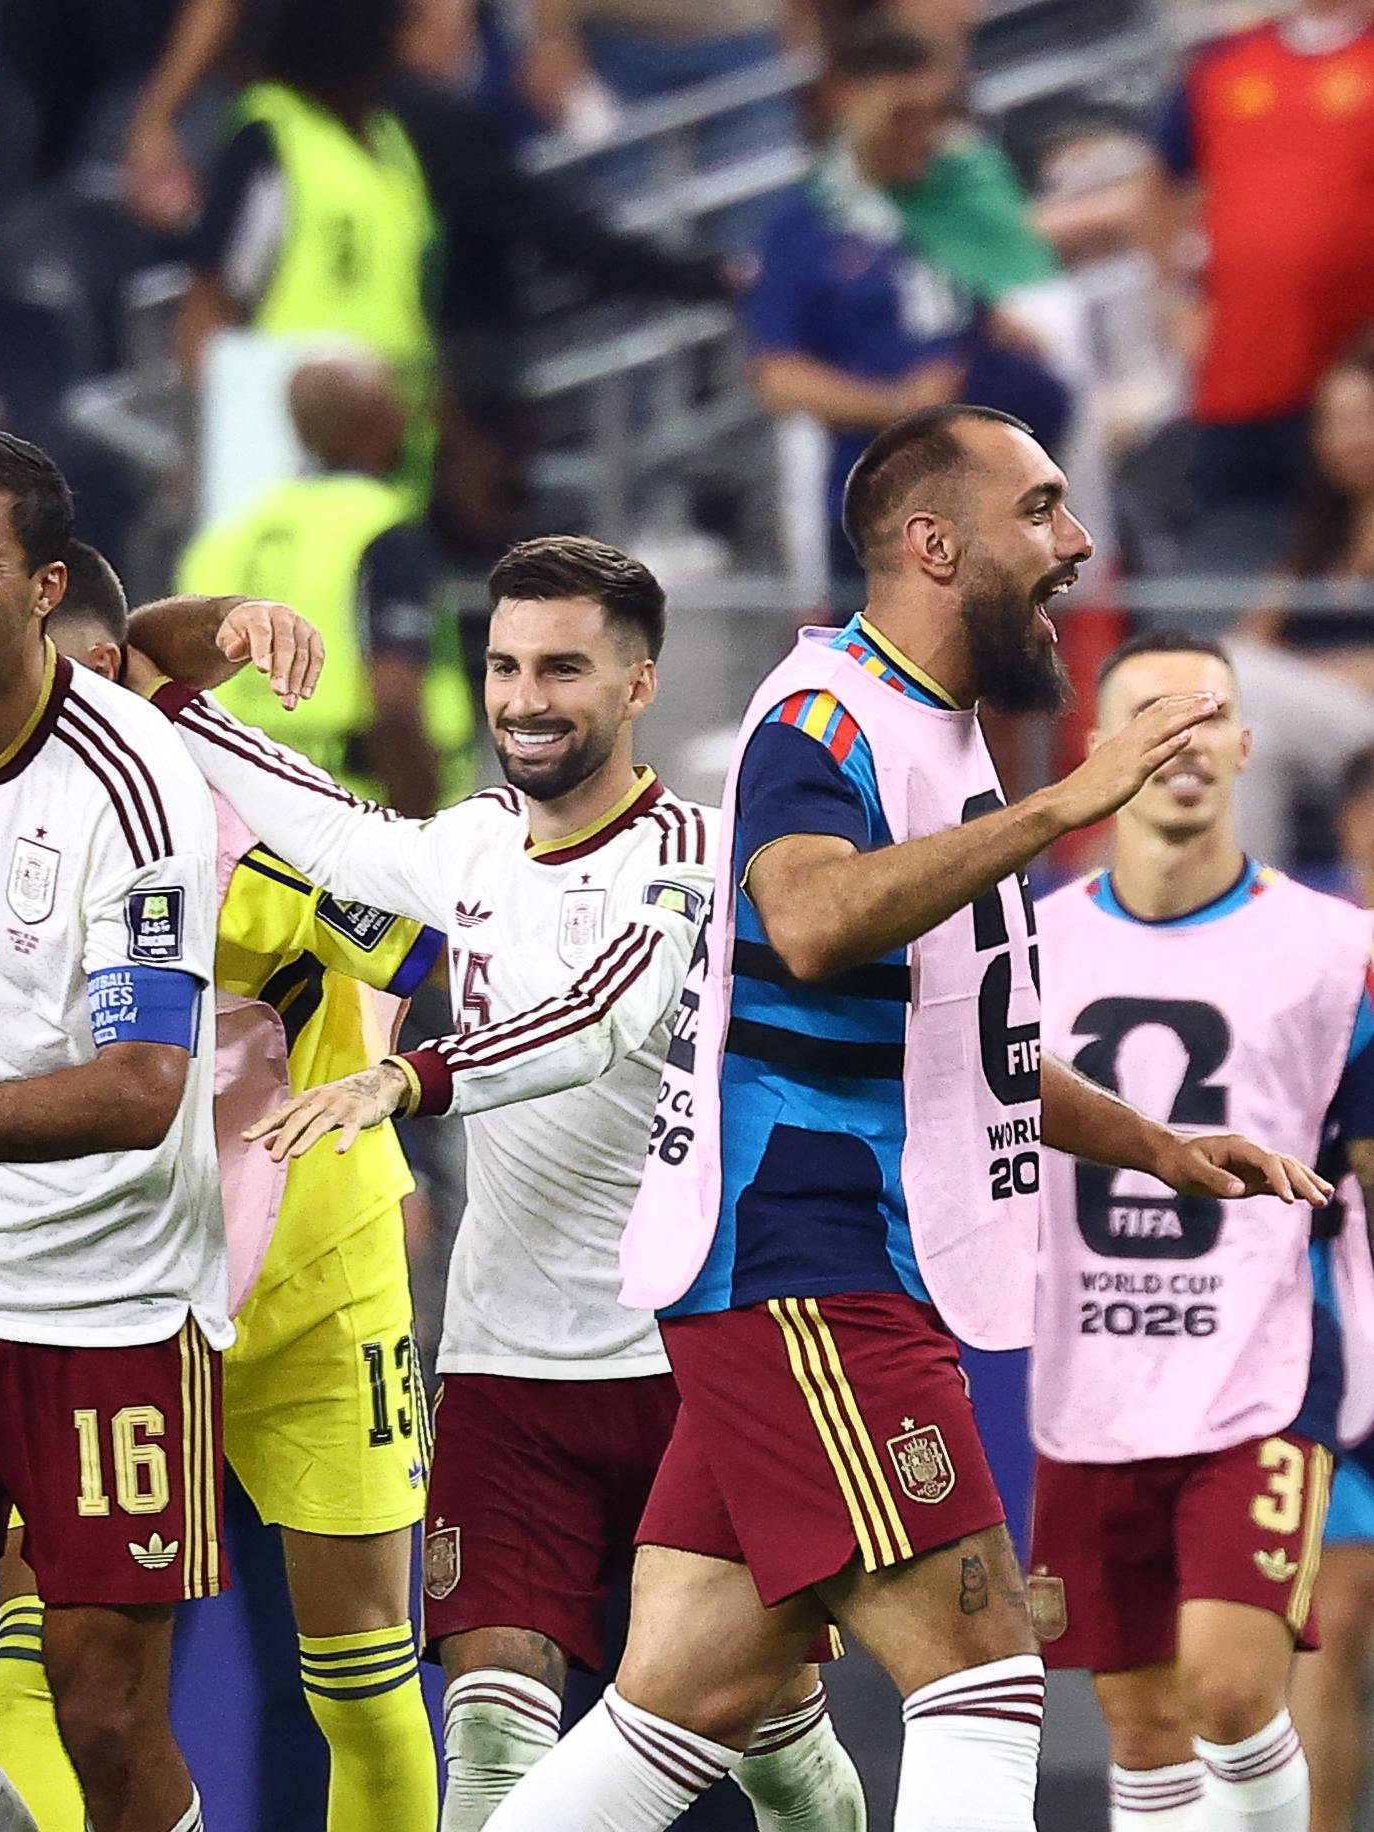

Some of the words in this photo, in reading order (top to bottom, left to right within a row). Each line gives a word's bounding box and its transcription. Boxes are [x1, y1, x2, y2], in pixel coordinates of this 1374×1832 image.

[352, 905, 382, 937] EDUCAT
[450, 947, 493, 1034] 5
[1006, 1038, 1041, 1076] FIF
[987, 1114, 1041, 1151] WORL
[989, 1151, 1040, 1201] 20
[1108, 1206, 1183, 1239] FIFA
[1080, 1272, 1163, 1295] WORLD
[1170, 1273, 1224, 1295] CUP
[1080, 1300, 1221, 1338] 2026
[362, 1334, 414, 1448] 13
[73, 1405, 171, 1517] 16
[1249, 1436, 1305, 1536] 3
